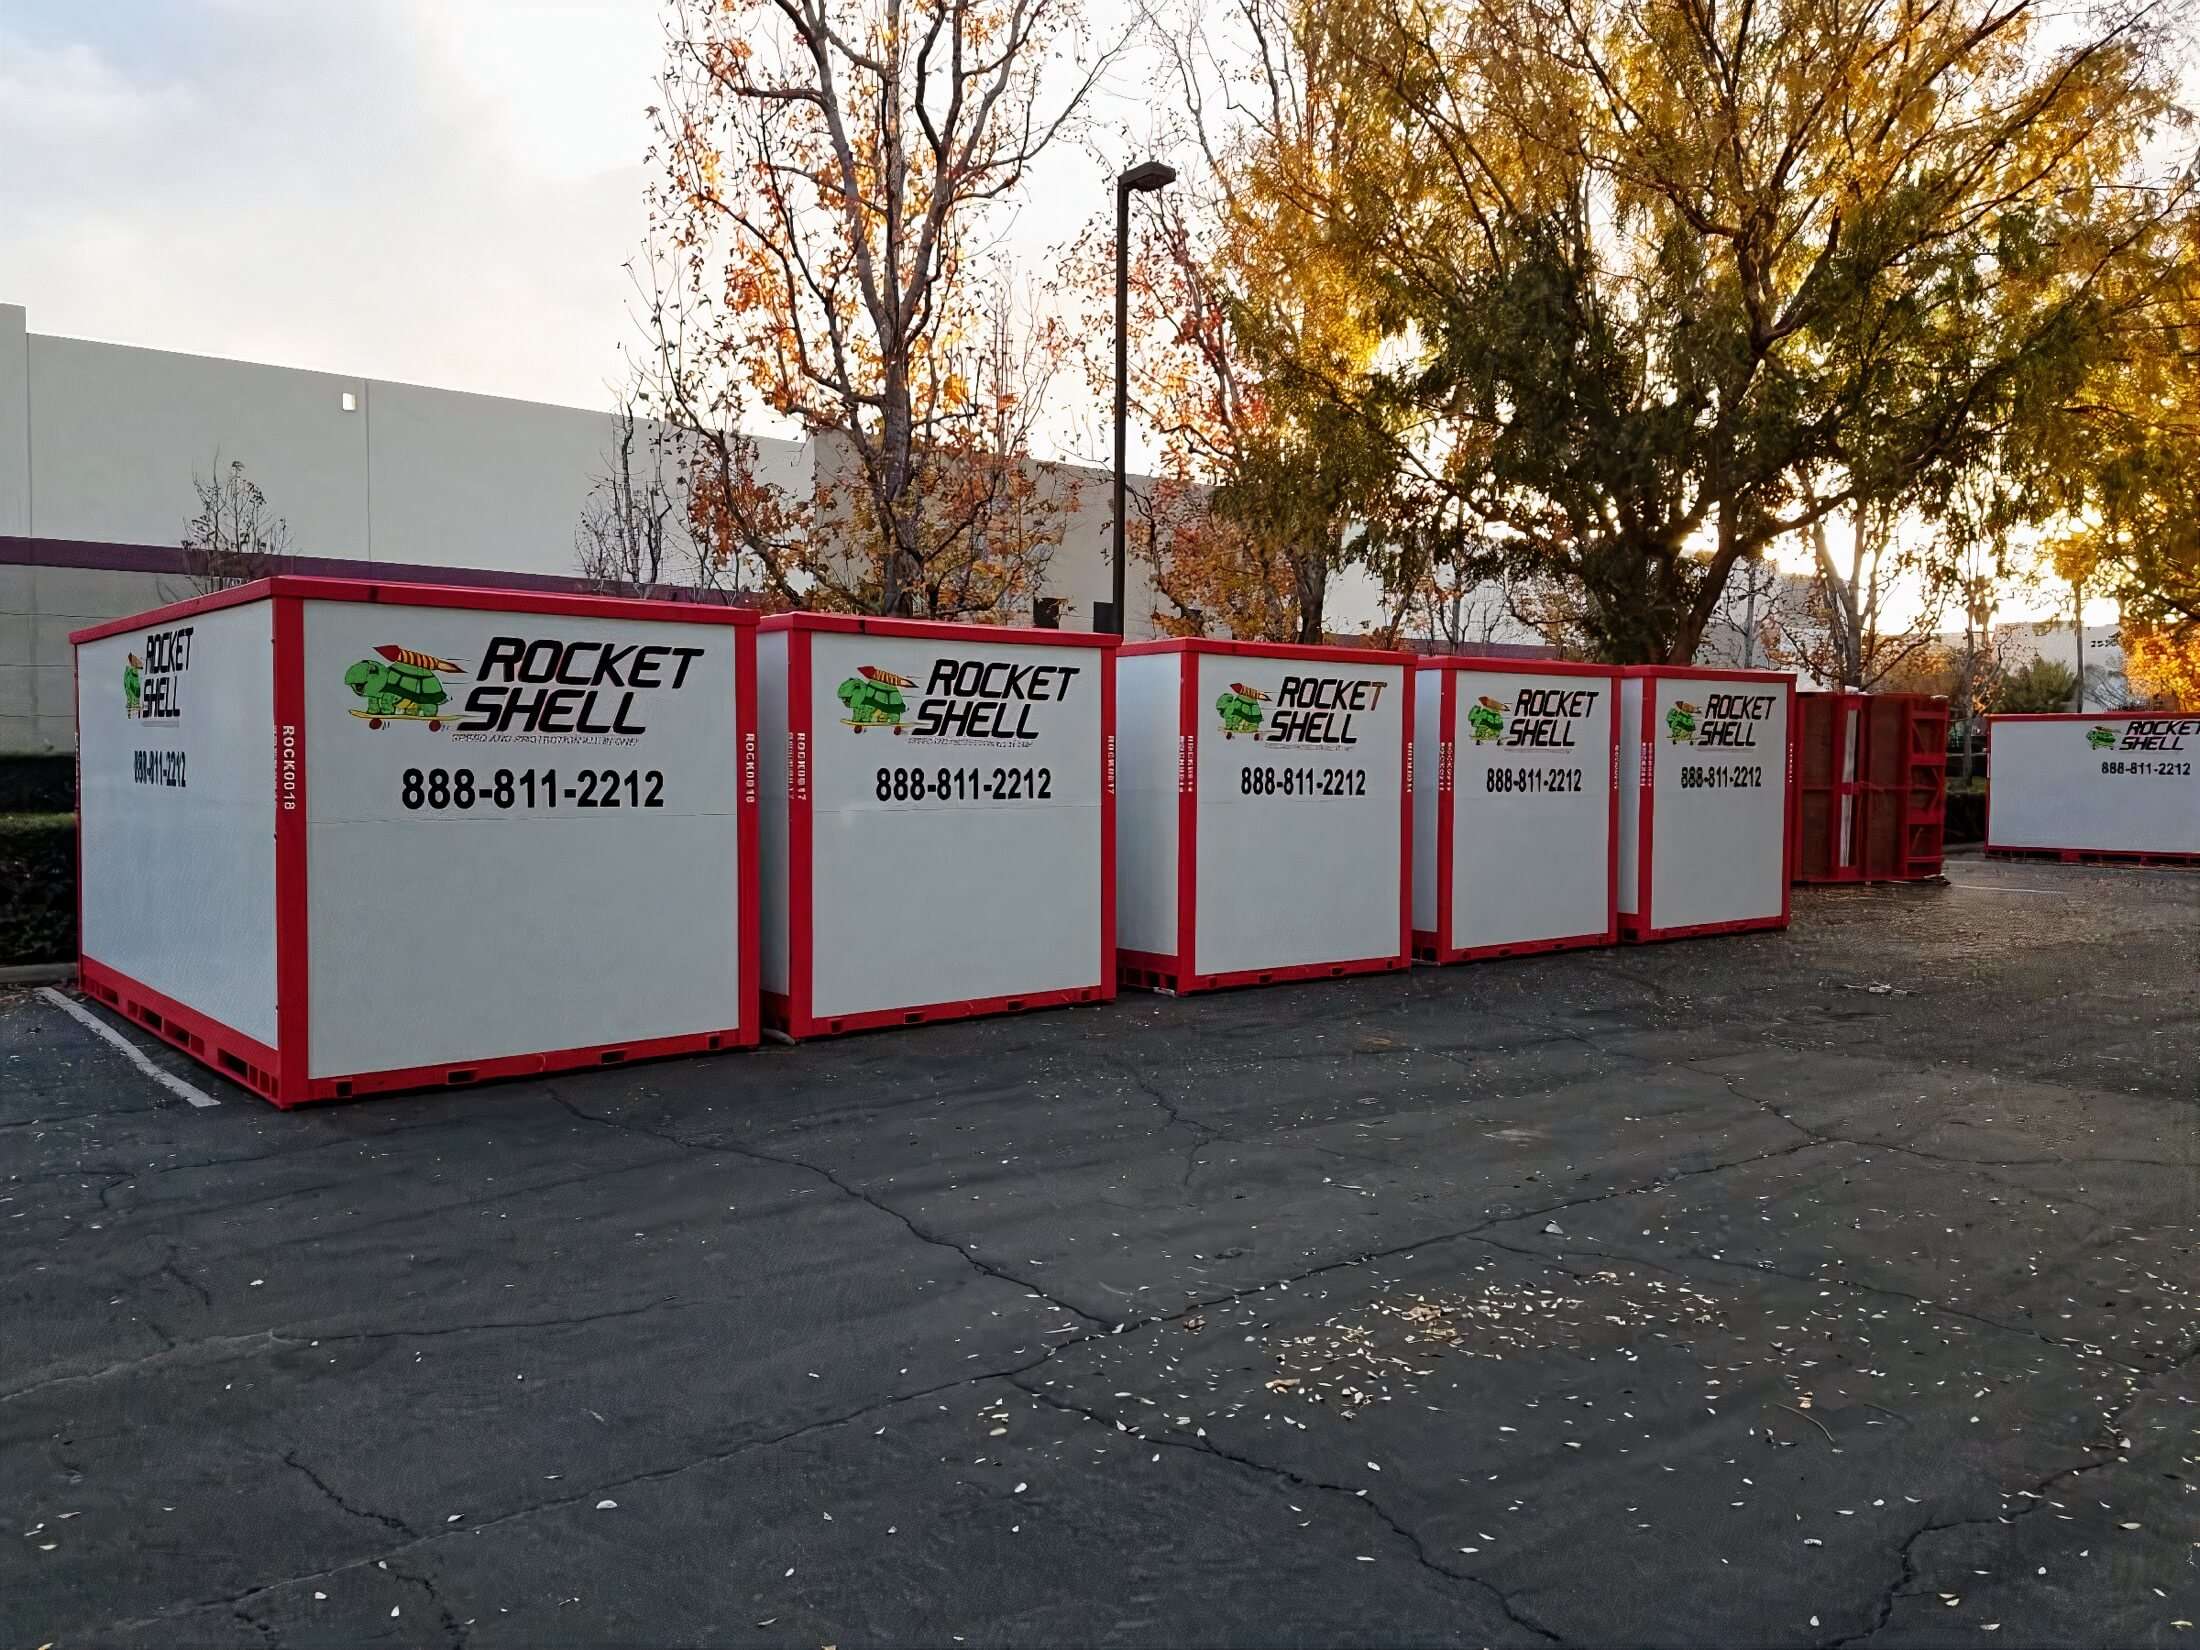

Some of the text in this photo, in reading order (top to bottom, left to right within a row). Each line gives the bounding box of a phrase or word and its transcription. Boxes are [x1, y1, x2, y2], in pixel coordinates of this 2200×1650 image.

[145, 627, 194, 674] ROCKET
[476, 637, 704, 688] ROCKET
[926, 659, 1080, 702] ROCKET
[1277, 677, 1387, 710] ROCKET
[143, 677, 181, 718] SHELL
[457, 686, 646, 735] SHELL
[1514, 689, 1599, 718] ROCKET
[1705, 693, 1776, 720] ROCKET
[911, 700, 1039, 739] SHELL
[1267, 711, 1357, 743] SHELL
[1507, 718, 1576, 746] SHELL
[1697, 720, 1757, 746] SHELL
[2118, 736, 2185, 751] SHELL
[283, 724, 296, 810] ROCK0018
[1241, 767, 1365, 795] 888-811-2212
[1487, 768, 1581, 792] 888-811-2212
[1681, 766, 1762, 788] 888-811-2212
[2102, 762, 2191, 776] 888-811-2212
[402, 768, 663, 809] 888-811-2212
[876, 768, 1051, 801] 888-811-2212
